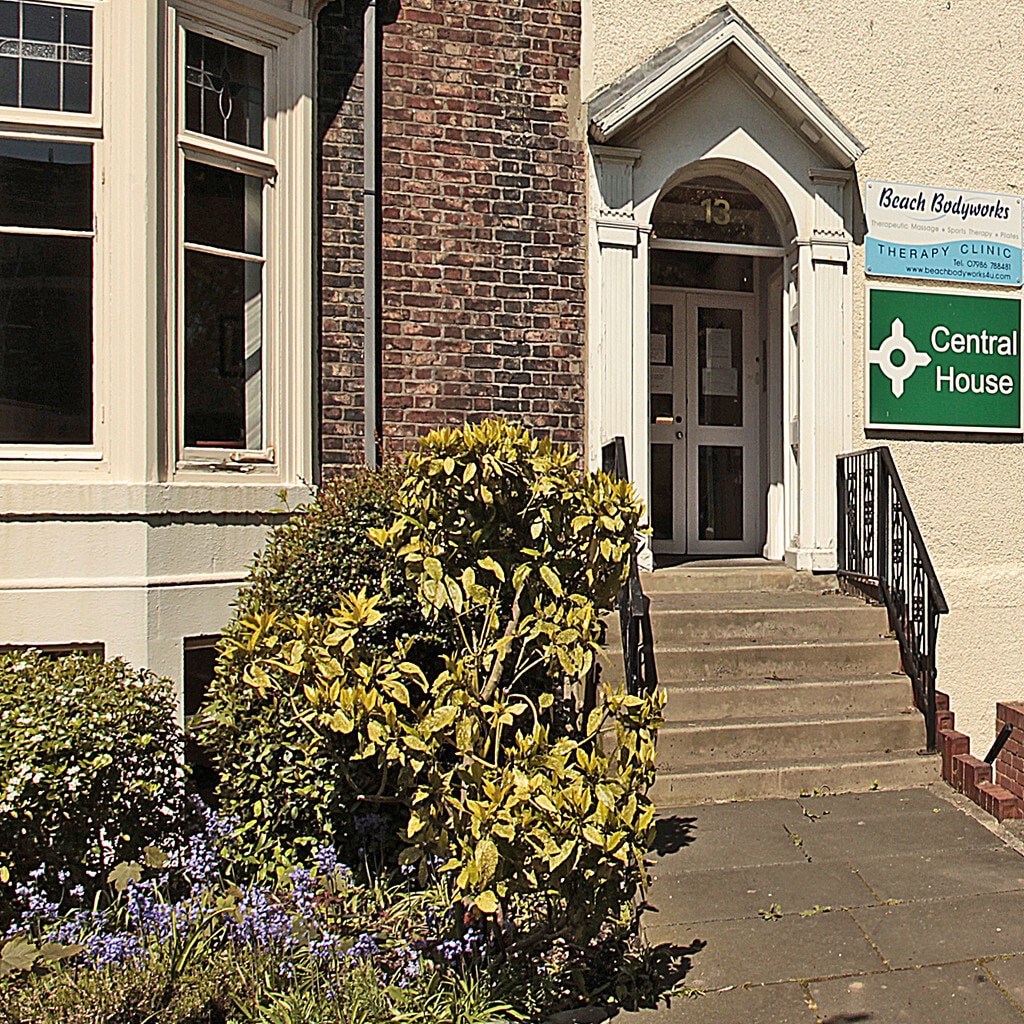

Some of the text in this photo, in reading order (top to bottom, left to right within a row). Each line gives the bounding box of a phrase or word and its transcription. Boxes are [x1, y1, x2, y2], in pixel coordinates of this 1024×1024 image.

[701, 198, 731, 225] 13
[879, 187, 1010, 220] Beach Bodyworks
[872, 220, 908, 231] Therapeutic
[911, 223, 939, 233] Massage
[947, 227, 966, 235] Sports
[968, 228, 993, 238] Therapy
[878, 244, 1012, 259] THERAPY CLINIC
[906, 265, 1012, 281] www.beachbodyworks4u.com
[967, 260, 987, 269] 07986
[990, 261, 1011, 271] 788481
[931, 326, 1018, 355] Central
[936, 365, 1014, 395] House
